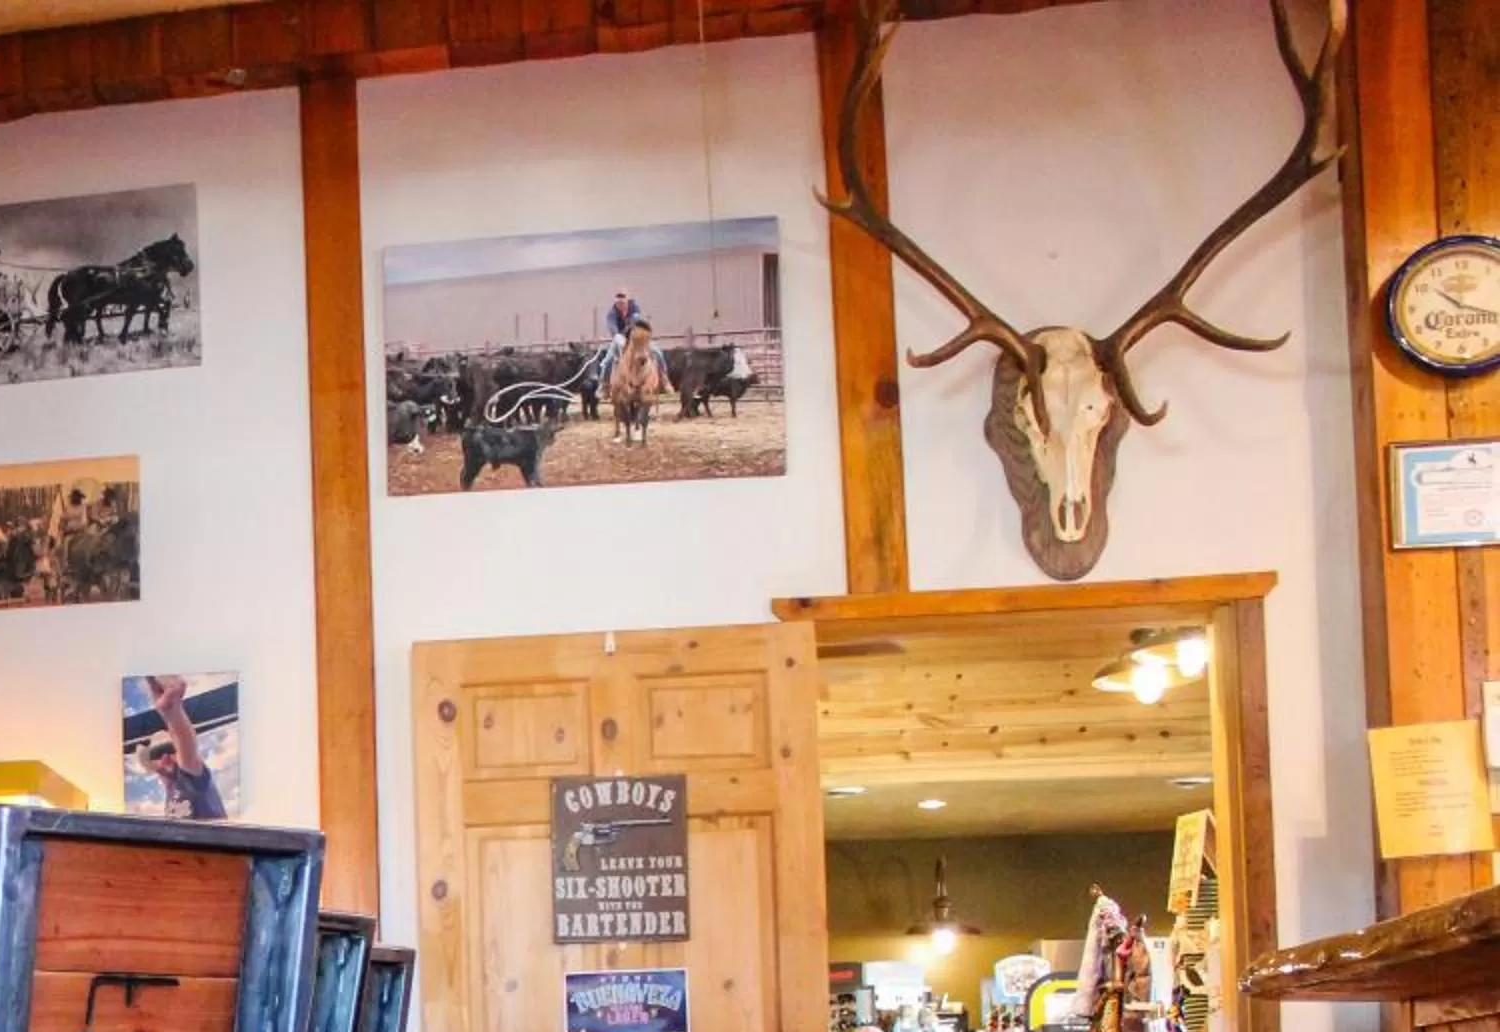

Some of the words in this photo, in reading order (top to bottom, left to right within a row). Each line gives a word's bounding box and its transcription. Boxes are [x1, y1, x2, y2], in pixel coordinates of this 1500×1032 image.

[1424, 311, 1497, 331] Corona
[564, 780, 676, 813] COWBOYS
[601, 855, 644, 871] LEAVE
[650, 855, 683, 869] YOUR
[555, 873, 686, 899] SIX-SHOOTER
[557, 911, 686, 937] BARTENDER
